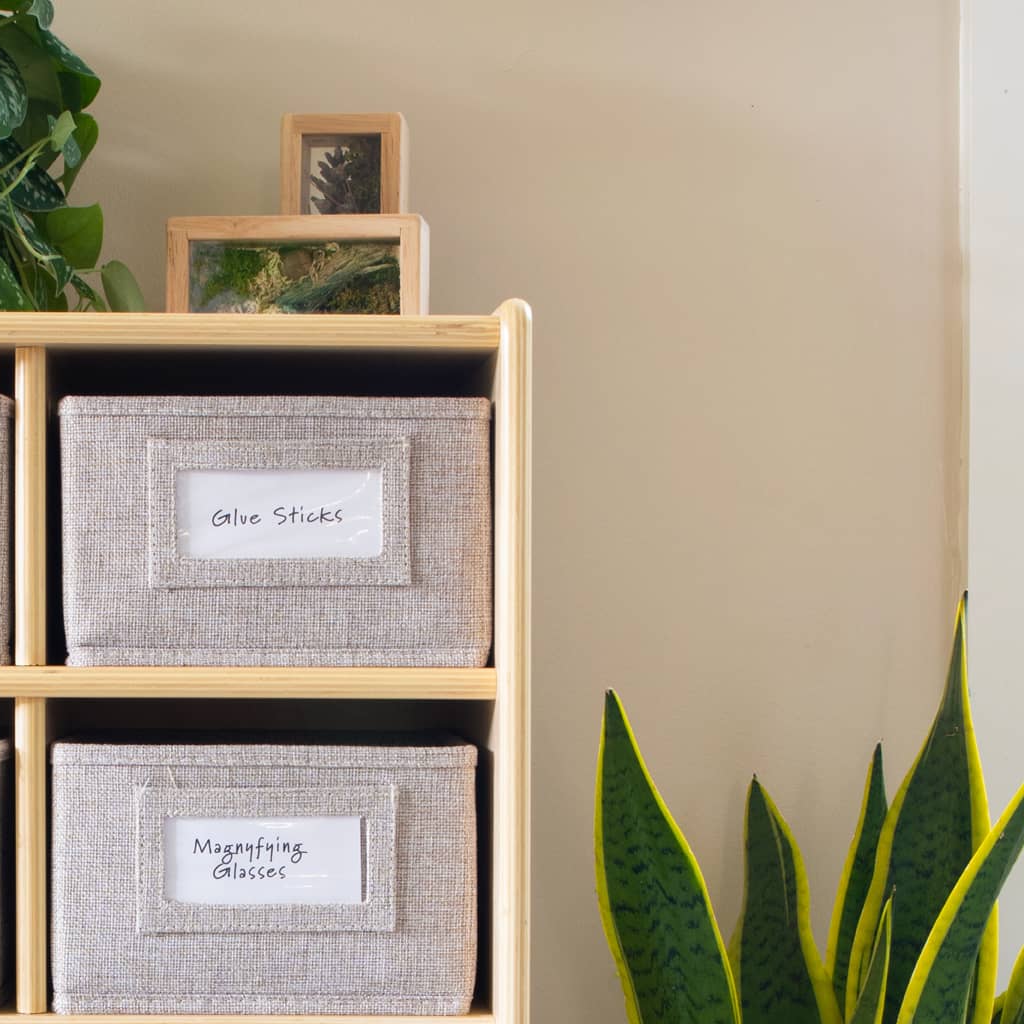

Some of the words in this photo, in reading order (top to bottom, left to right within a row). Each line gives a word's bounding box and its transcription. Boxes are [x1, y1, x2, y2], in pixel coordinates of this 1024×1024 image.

[211, 507, 261, 528] Glue
[273, 506, 343, 527] Sticks
[211, 862, 287, 881] Glasses
